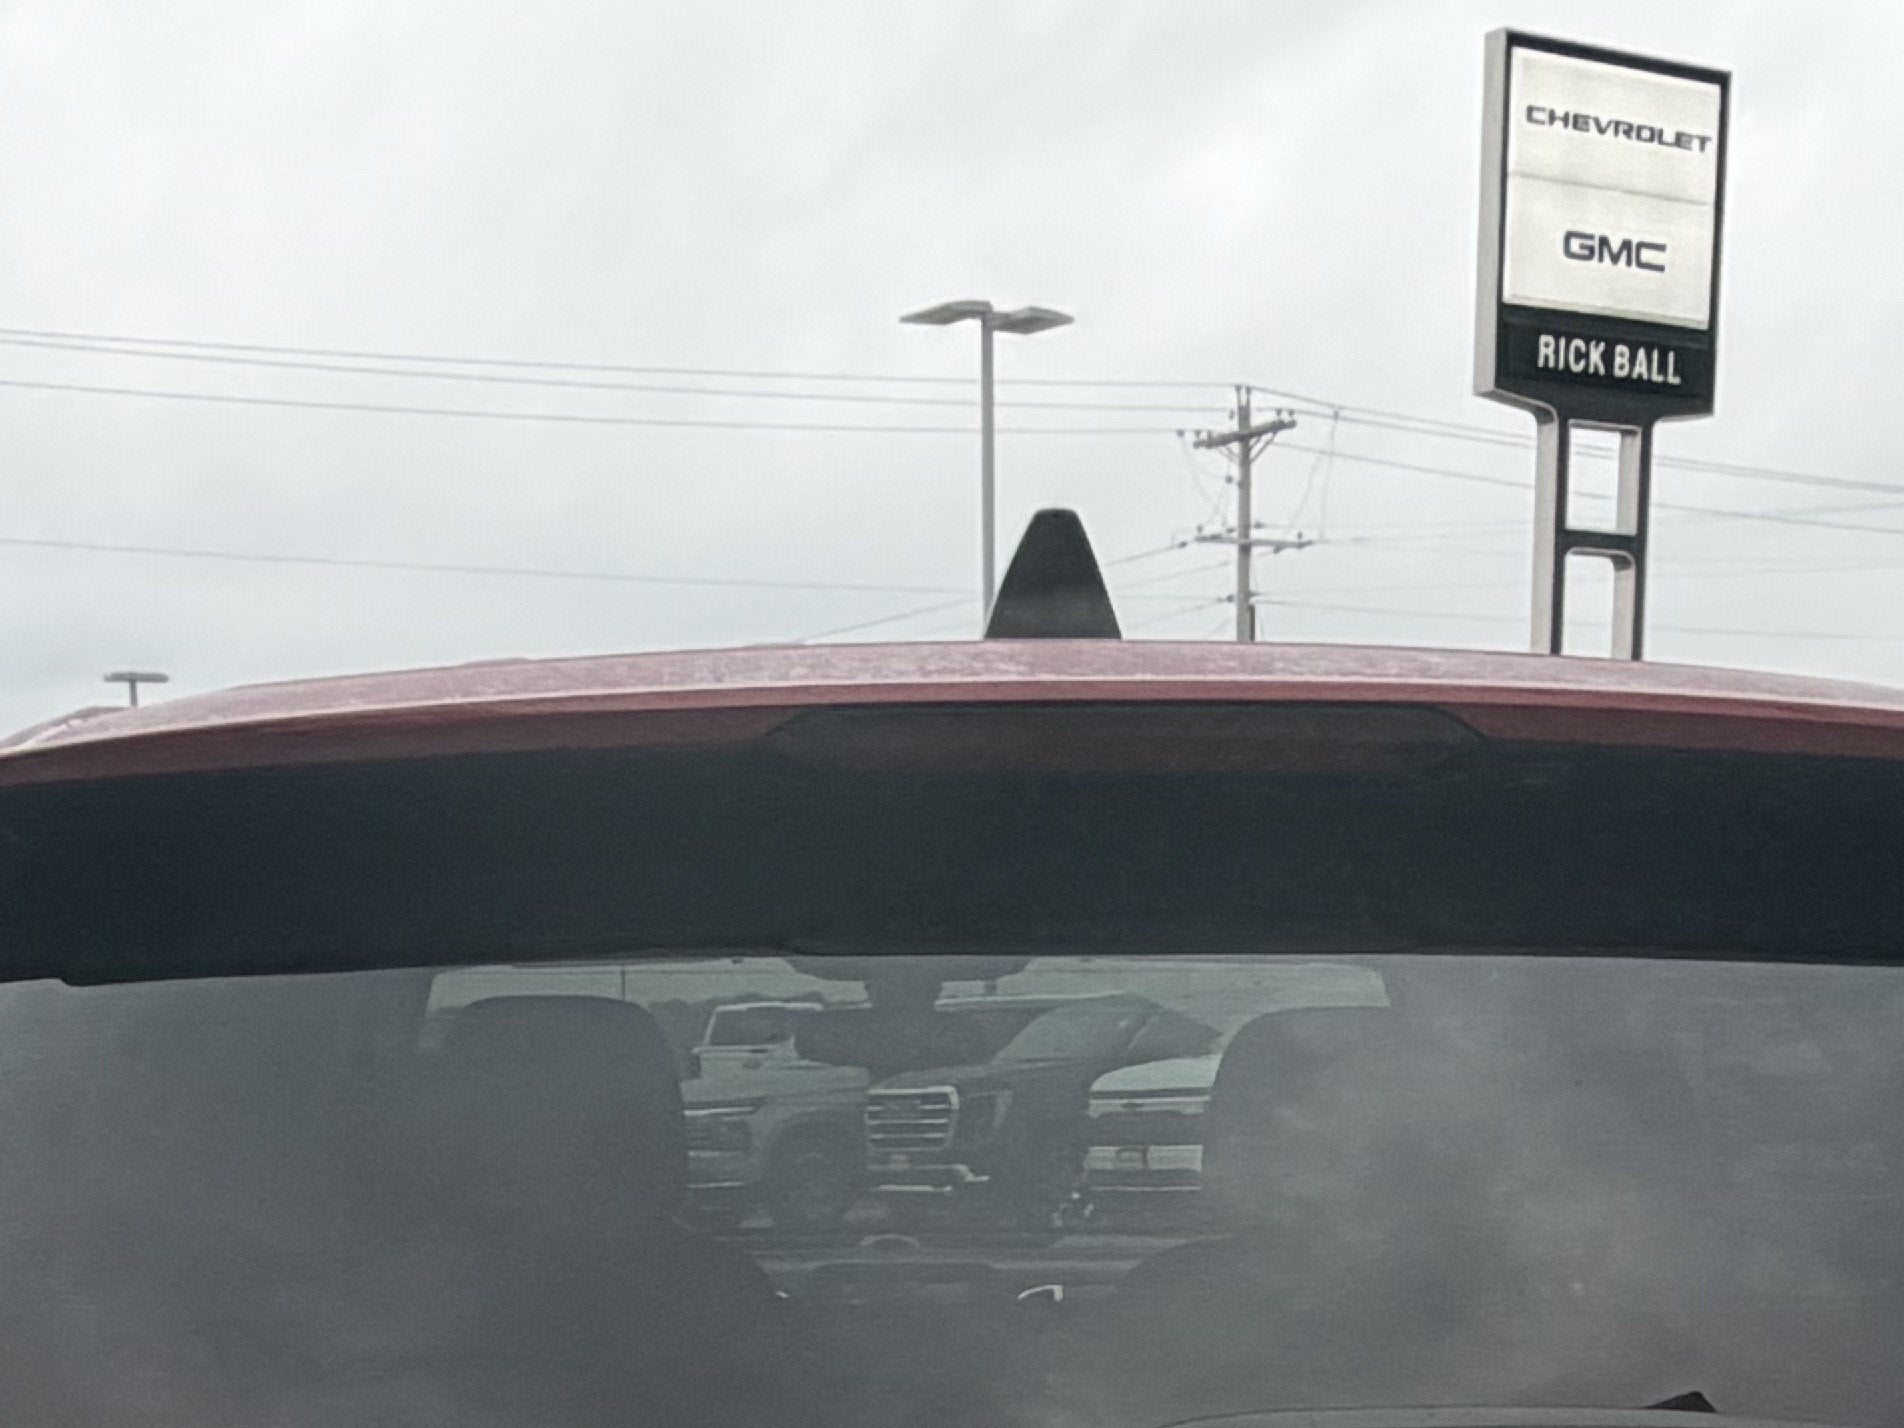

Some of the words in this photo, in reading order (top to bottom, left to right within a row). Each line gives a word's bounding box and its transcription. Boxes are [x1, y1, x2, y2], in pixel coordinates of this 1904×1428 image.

[1526, 105, 1711, 153] CHEVROLET
[1564, 231, 1666, 272] GMC
[1538, 335, 1605, 374] RICK
[1614, 344, 1681, 385] BALL
